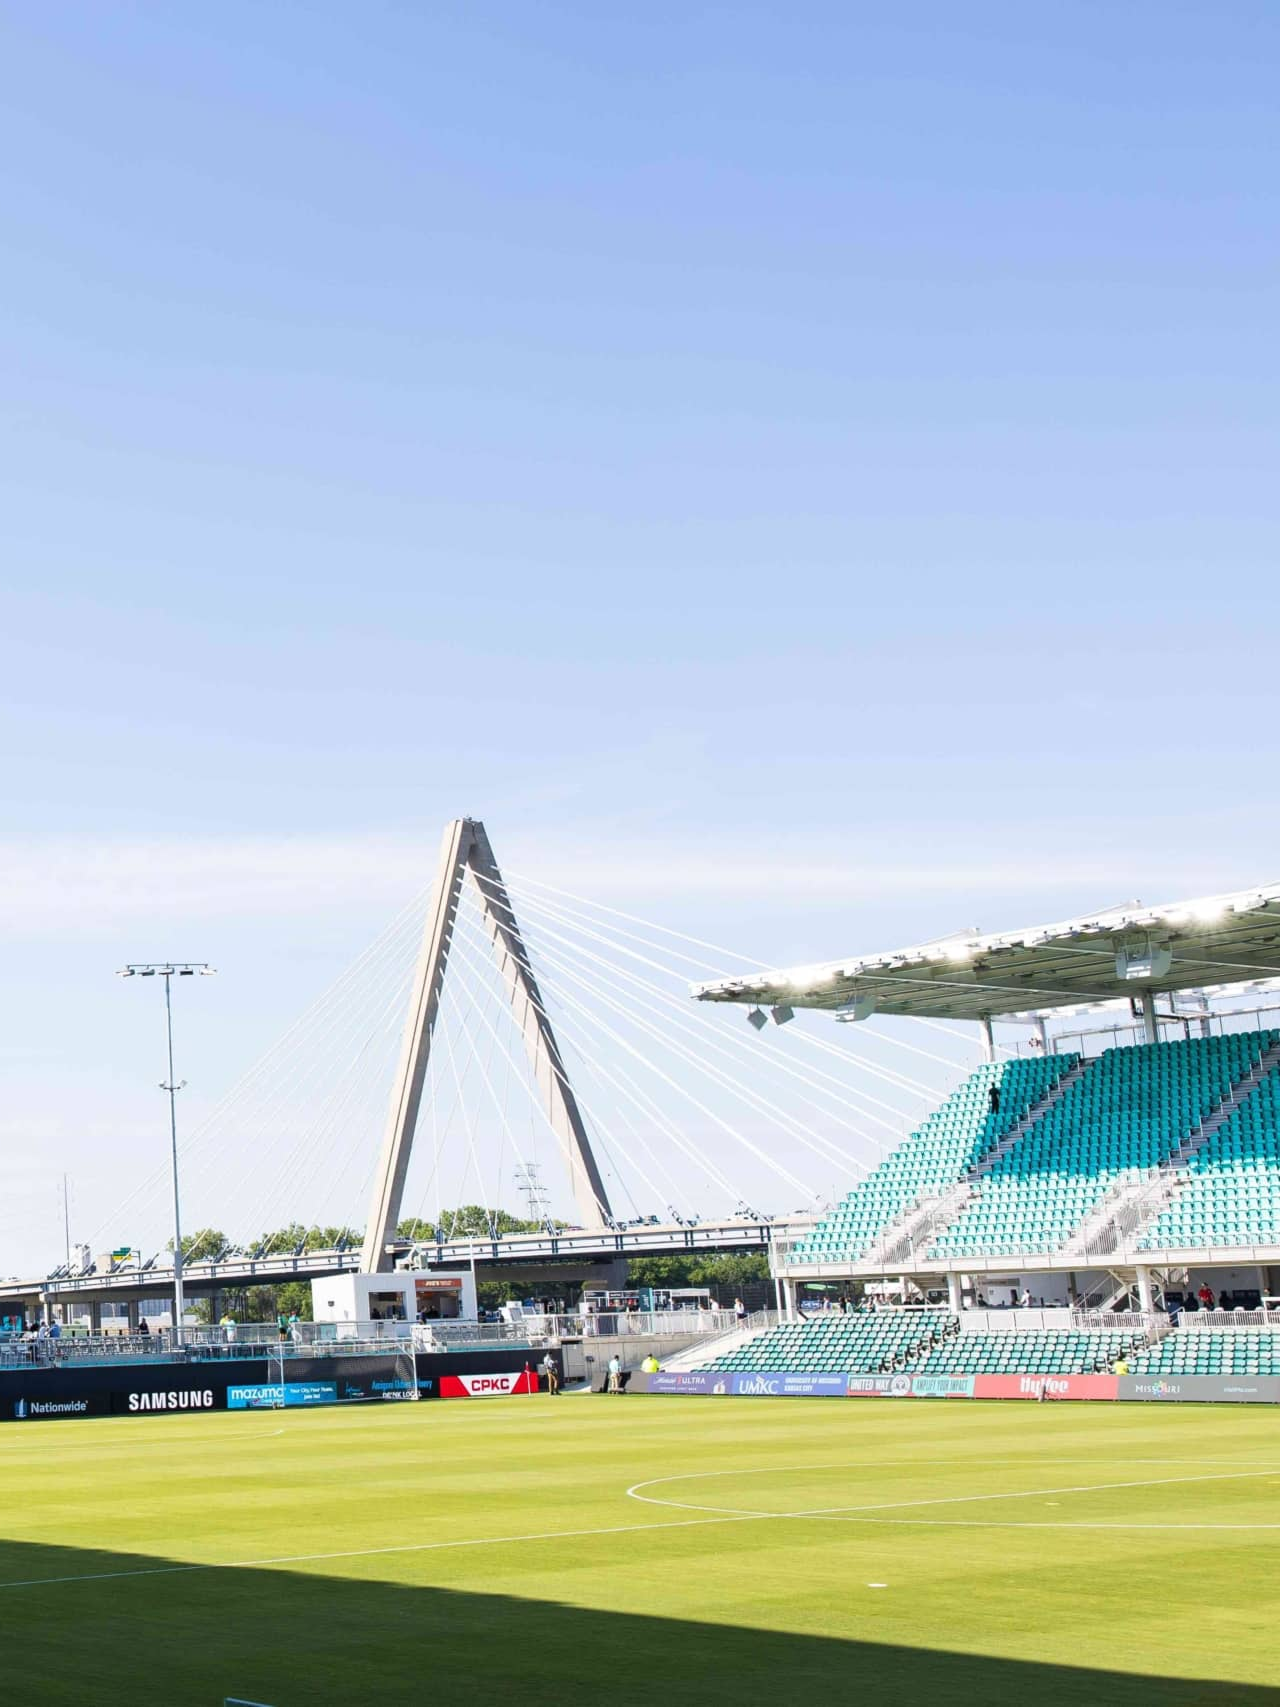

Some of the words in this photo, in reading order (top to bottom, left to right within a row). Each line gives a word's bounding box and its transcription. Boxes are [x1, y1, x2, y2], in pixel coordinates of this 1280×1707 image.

[471, 1378, 510, 1392] CPKC
[738, 1379, 779, 1394] UMKC
[850, 1378, 874, 1391] UNITED
[875, 1378, 891, 1391] WAY
[1135, 1384, 1181, 1393] MISSOURI
[30, 1400, 87, 1414] Nationwide
[128, 1390, 214, 1411] SAMSUNG
